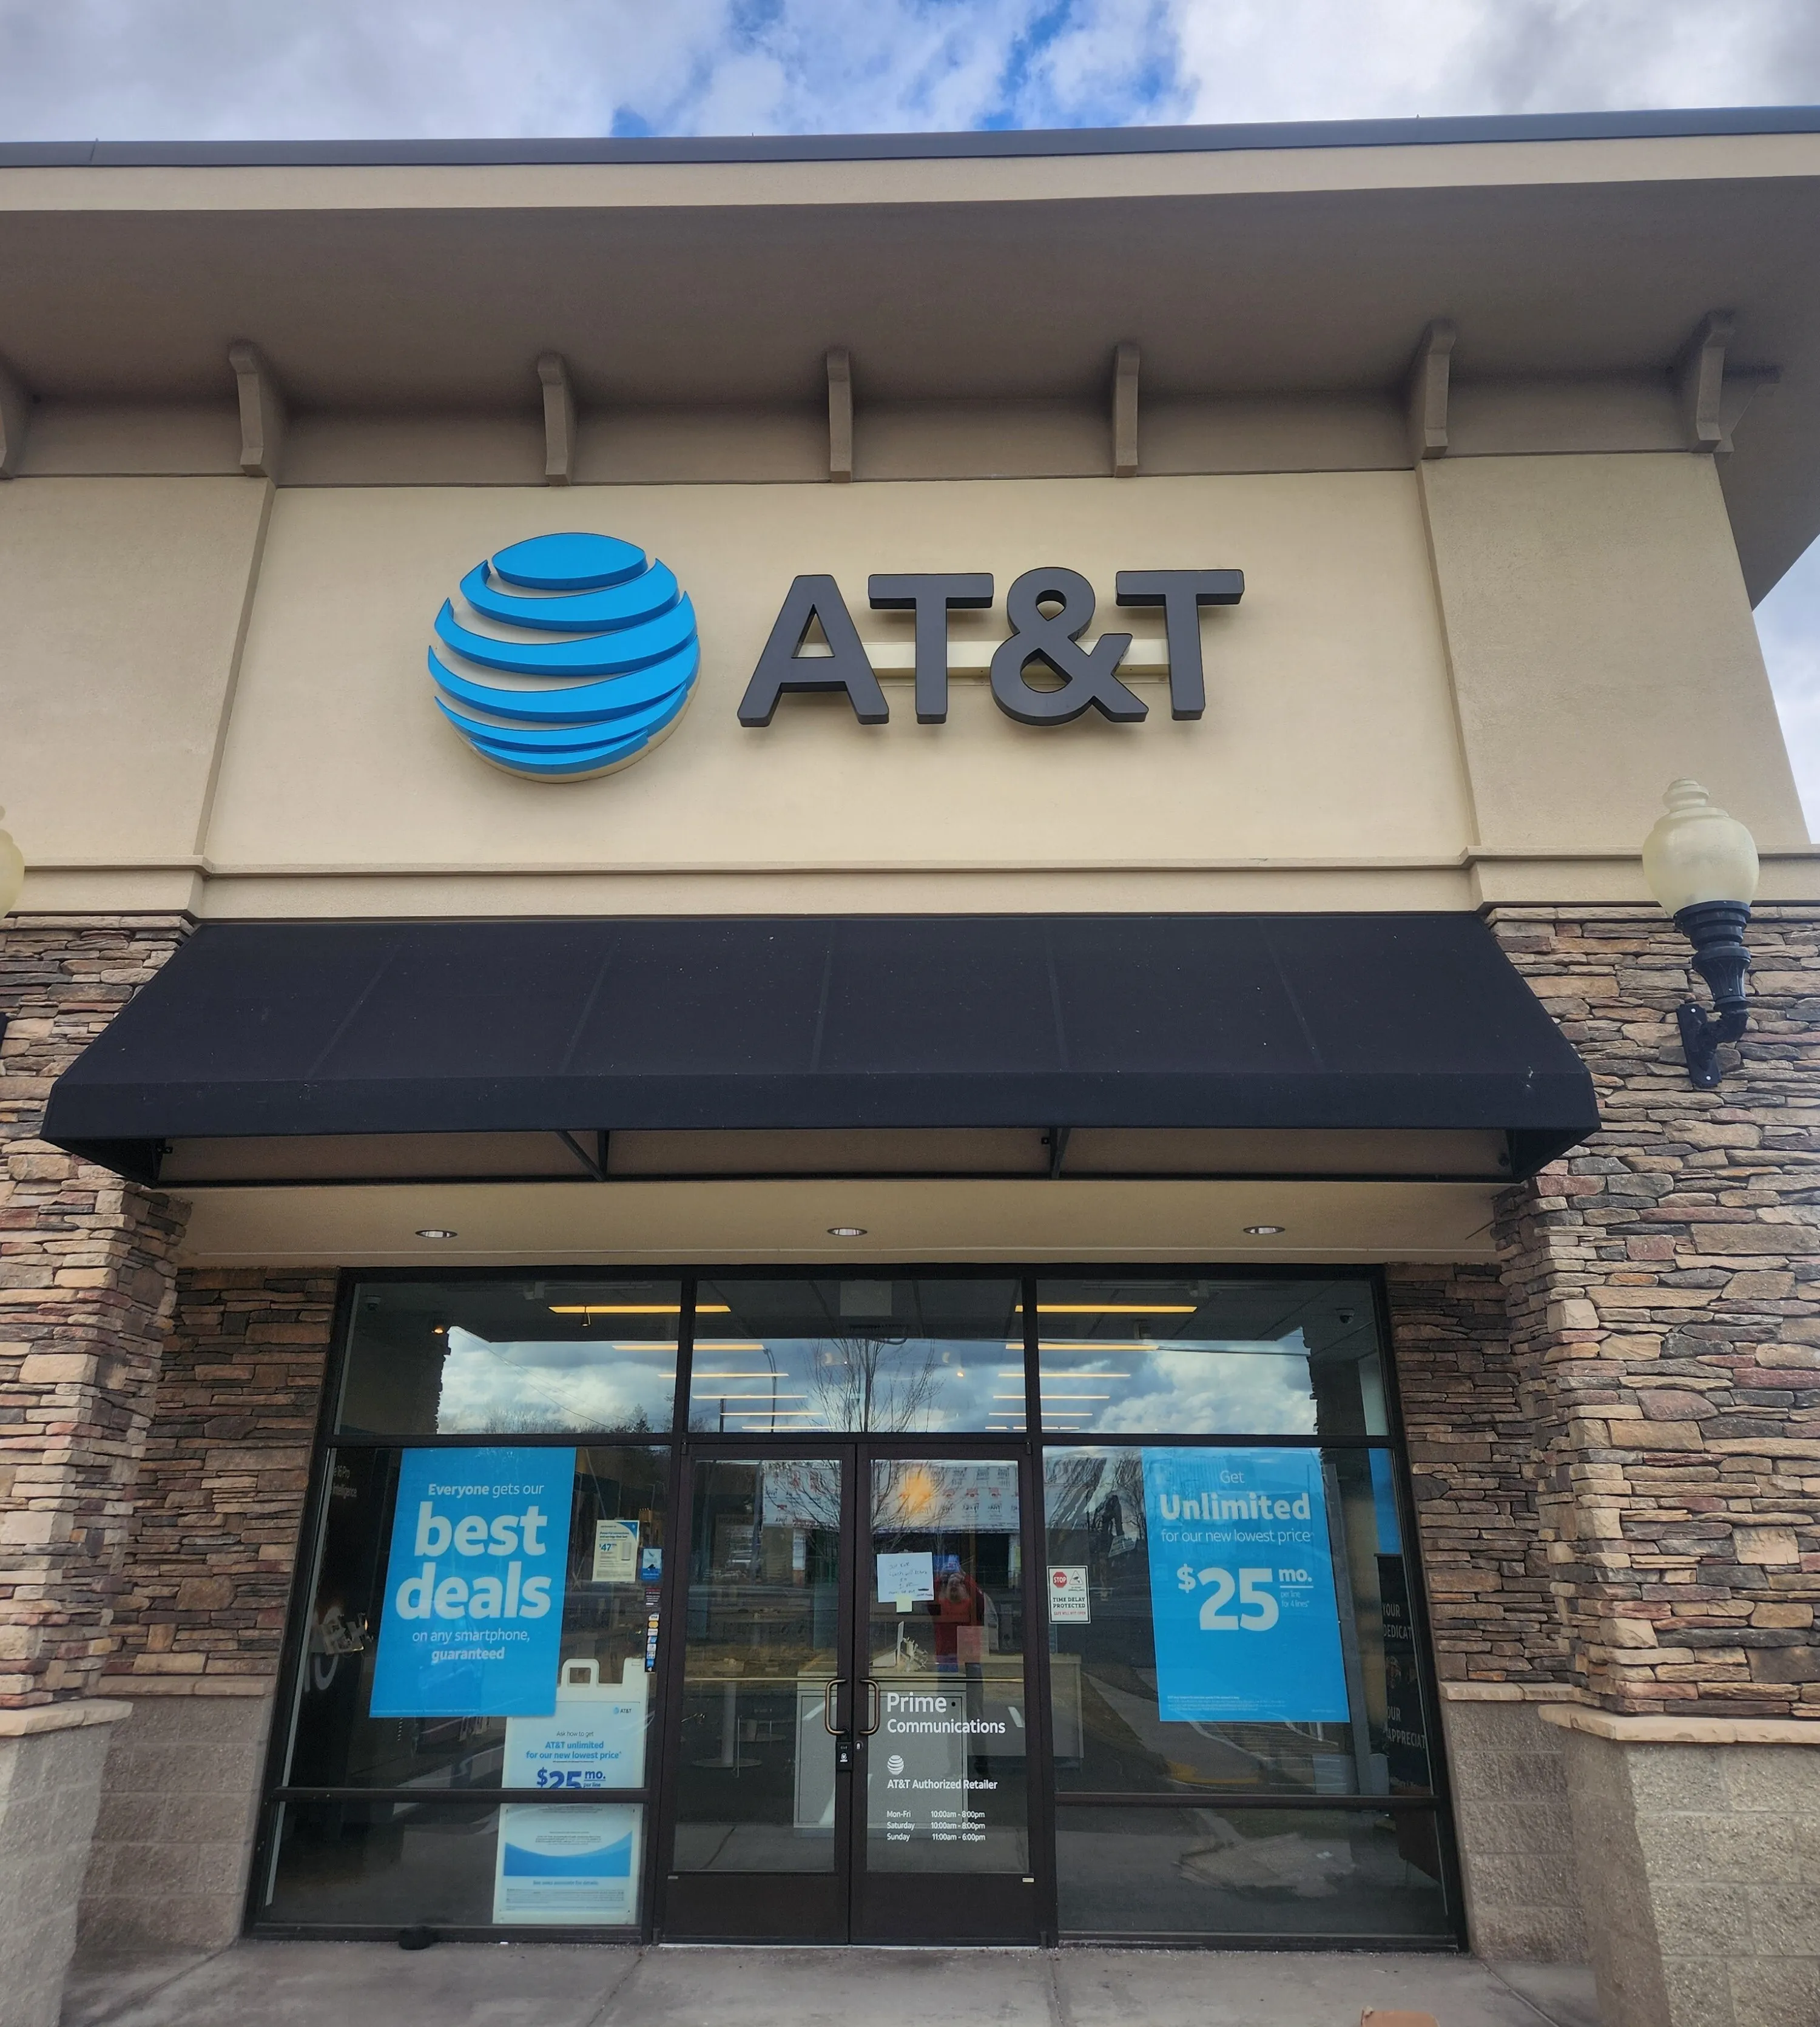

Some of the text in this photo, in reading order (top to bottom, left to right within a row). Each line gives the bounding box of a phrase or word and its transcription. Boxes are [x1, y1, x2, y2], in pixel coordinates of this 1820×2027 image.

[736, 566, 1245, 727] AT&T
[1220, 1470, 1245, 1483] Get
[428, 1483, 544, 1499] Everyone gets our
[1159, 1491, 1310, 1520] Unlimited
[414, 1501, 548, 1557] best
[1161, 1529, 1179, 1542] for
[1182, 1532, 1202, 1542] our
[1205, 1532, 1232, 1542] new
[1234, 1529, 1275, 1542] lowest
[396, 1561, 551, 1620] deals
[1176, 1563, 1313, 1631] $25 mo.
[1281, 1591, 1290, 1599] per
[1382, 1602, 1400, 1617] YOUR
[412, 1628, 530, 1644] on any smartphone,
[431, 1647, 505, 1664] guaranteed
[887, 1691, 947, 1713] Prime
[887, 1718, 1006, 1734] Communications
[567, 1741, 604, 1749] unlimited
[526, 1750, 538, 1759] for
[537, 1767, 606, 1789] $25 mo.
[887, 1779, 998, 1789] AT&T Authorized Retailer
[962, 1810, 985, 1819] 8:00pm
[886, 1821, 915, 1830] Saturday
[962, 1822, 985, 1830] 8:00pm
[886, 1832, 911, 1842] Sunday
[962, 1833, 986, 1842] 6:00pm
